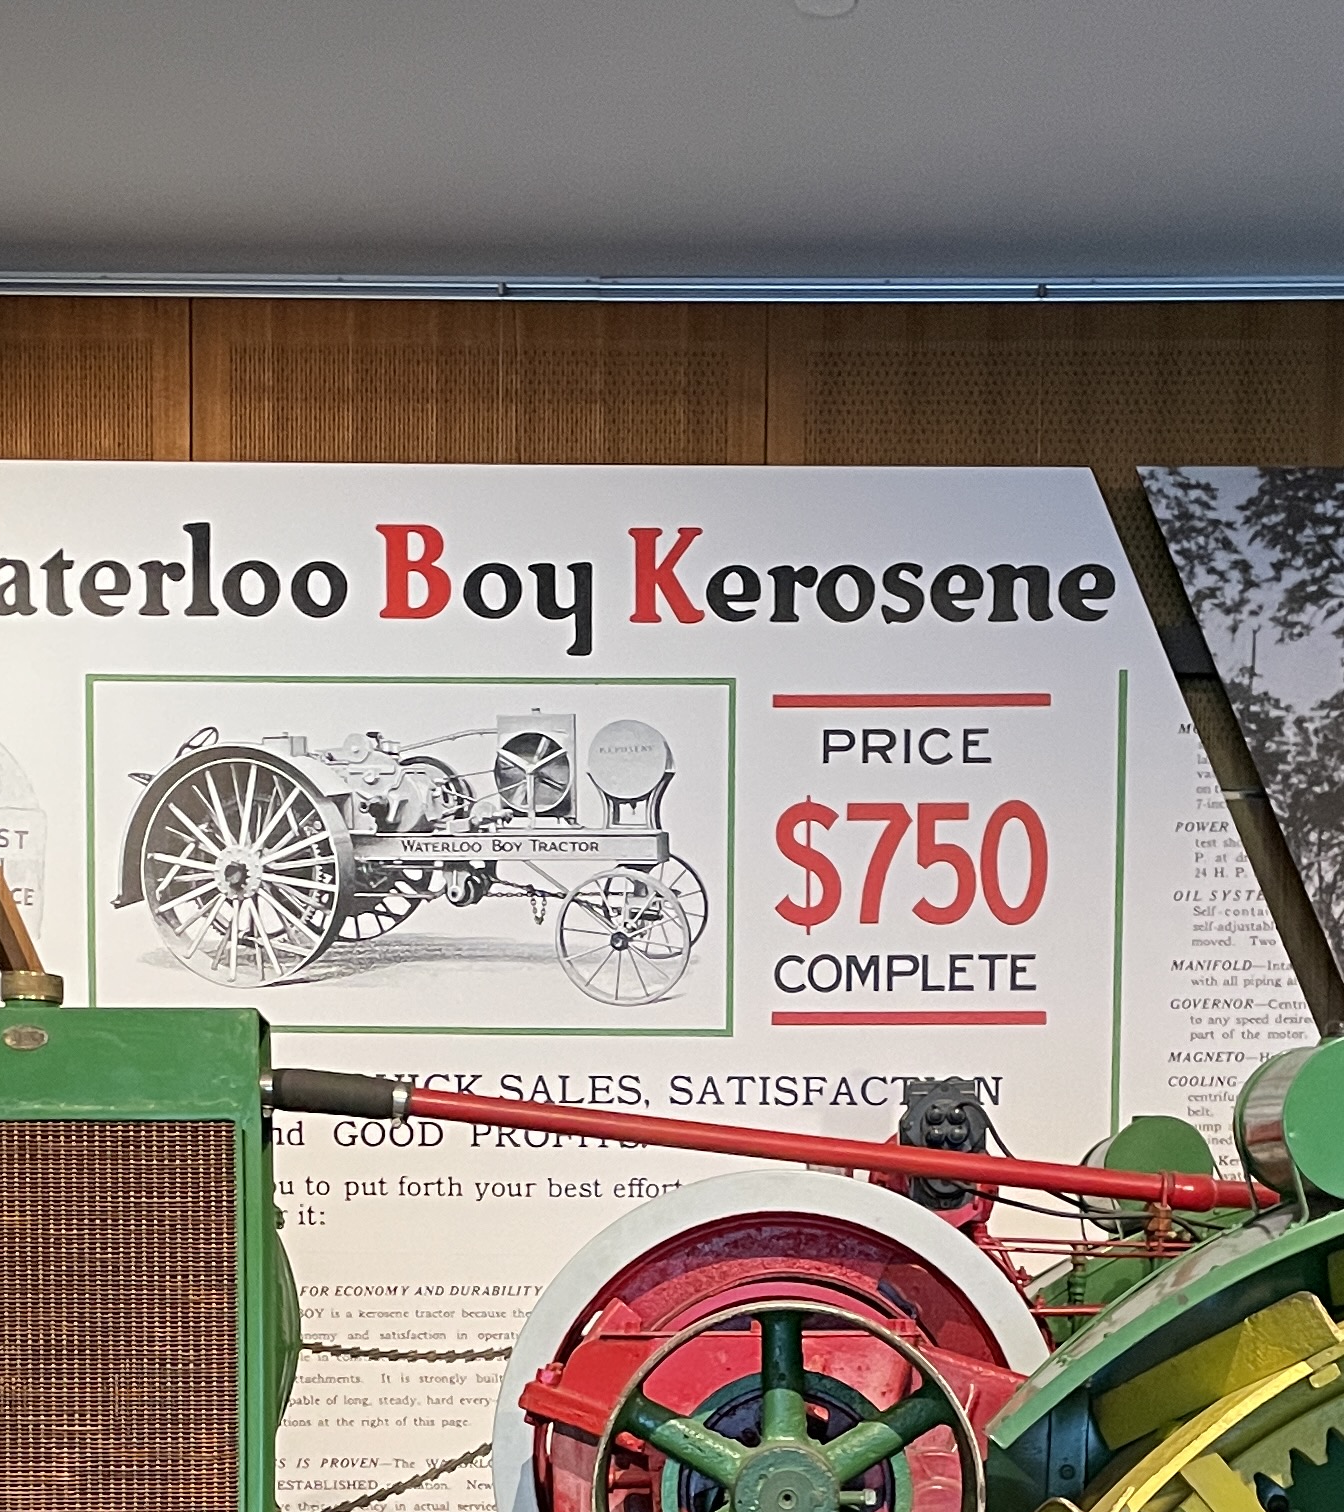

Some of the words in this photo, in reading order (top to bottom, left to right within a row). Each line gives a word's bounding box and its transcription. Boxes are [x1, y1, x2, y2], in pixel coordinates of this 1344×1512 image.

[376, 523, 593, 656] Boy
[626, 526, 1116, 625] Kerosene
[822, 728, 992, 765] PRICE
[1175, 821, 1229, 832] POWER
[401, 838, 482, 853] WATERLOO
[492, 838, 522, 853] BOY
[529, 838, 599, 853] TRACTOR
[776, 797, 1049, 936] $750
[1173, 890, 1202, 902] OIL
[775, 955, 1037, 996] COMPLETE
[1191, 976, 1217, 987] with
[1223, 976, 1238, 986] all
[1243, 976, 1282, 989] piping
[1190, 1015, 1203, 1025] to
[1208, 1017, 1229, 1027] any
[1190, 1030, 1214, 1042] part
[1222, 1029, 1234, 1040] of
[500, 1075, 650, 1109] SALES,
[670, 1076, 1003, 1106] SATISFACTN
[333, 1121, 444, 1147] GOOD
[305, 1176, 330, 1196] to
[344, 1177, 389, 1200] put
[398, 1175, 463, 1197] forth
[474, 1180, 537, 1201] your
[547, 1178, 604, 1198] best
[298, 1203, 326, 1226] it:
[299, 1286, 329, 1297] FOR
[335, 1285, 409, 1297] ECONOMY
[414, 1285, 444, 1297] AND
[449, 1285, 544, 1297] DURABILITY
[331, 1308, 340, 1318] is
[358, 1309, 409, 1319] kerosene
[415, 1309, 455, 1318] tractor
[461, 1308, 507, 1318] because
[347, 1330, 369, 1341] and
[380, 1330, 446, 1341] satisfaction
[457, 1331, 468, 1340] in
[381, 1374, 391, 1384] It
[401, 1374, 410, 1384] is
[419, 1373, 467, 1386] strongly
[326, 1395, 338, 1405] of
[427, 1395, 454, 1405] hard
[317, 1418, 331, 1427] at
[336, 1417, 355, 1427] the
[361, 1417, 390, 1429] right
[395, 1417, 408, 1427] of
[413, 1417, 436, 1427] this
[296, 1458, 311, 1469] IS
[395, 1501, 406, 1511] in
[413, 1501, 450, 1511] actual
